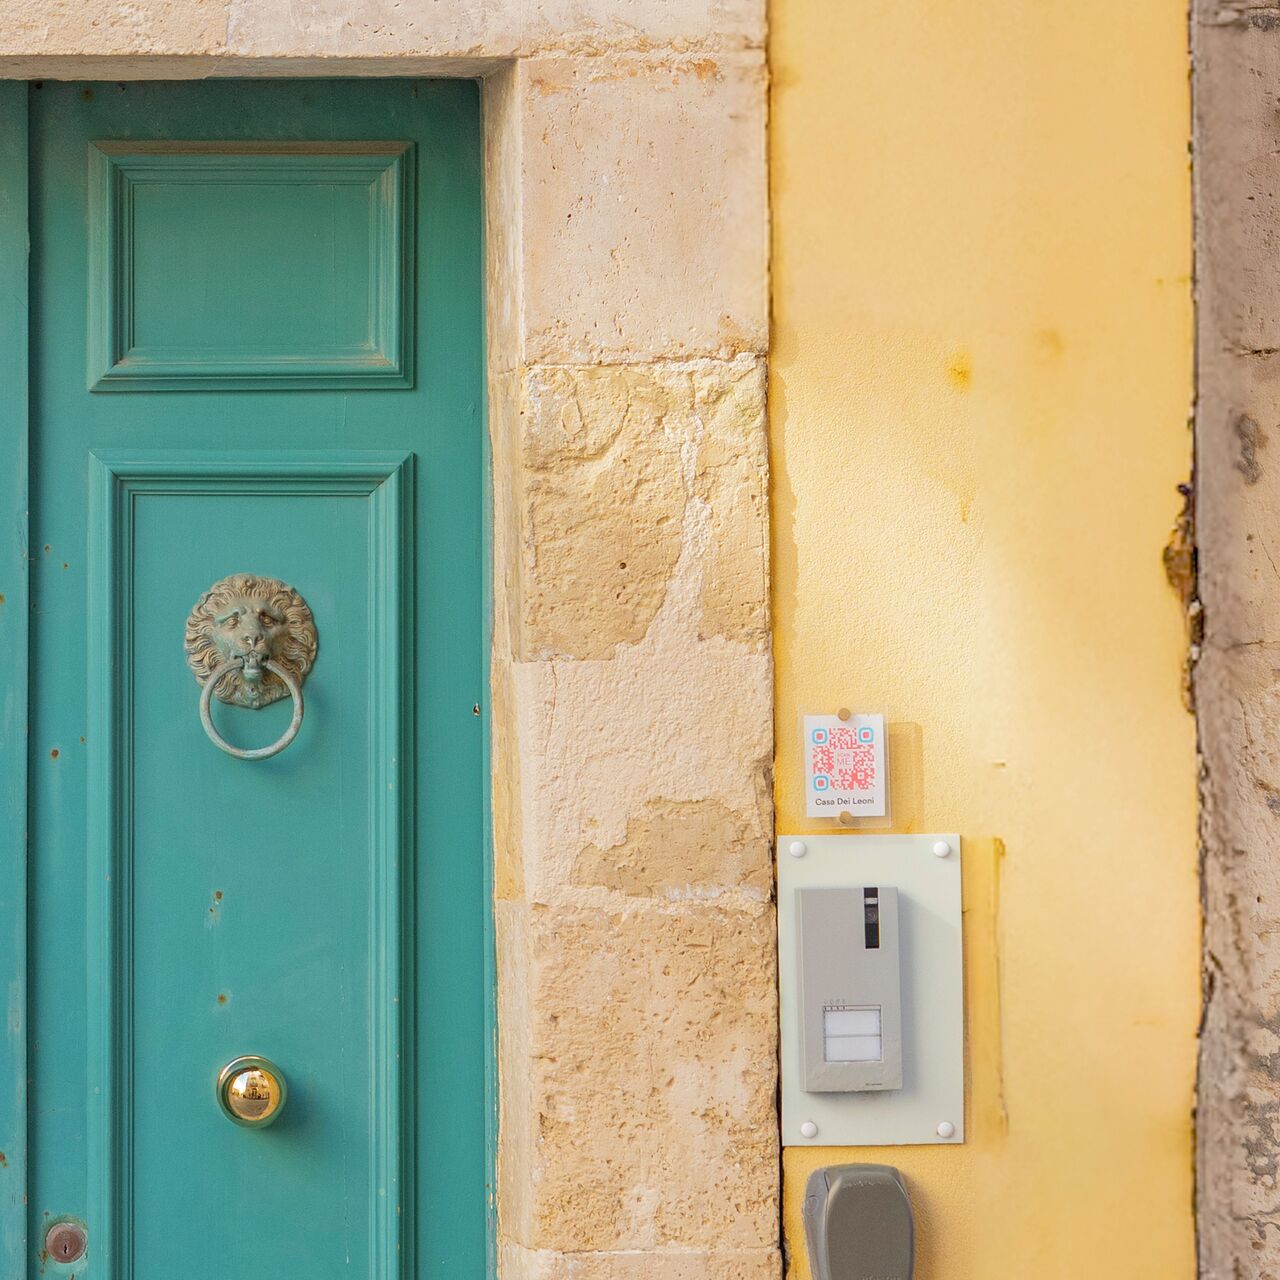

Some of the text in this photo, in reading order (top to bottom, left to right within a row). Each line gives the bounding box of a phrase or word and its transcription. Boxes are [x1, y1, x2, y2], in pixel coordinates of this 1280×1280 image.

[815, 796, 875, 806] Casa Dei Leoni
